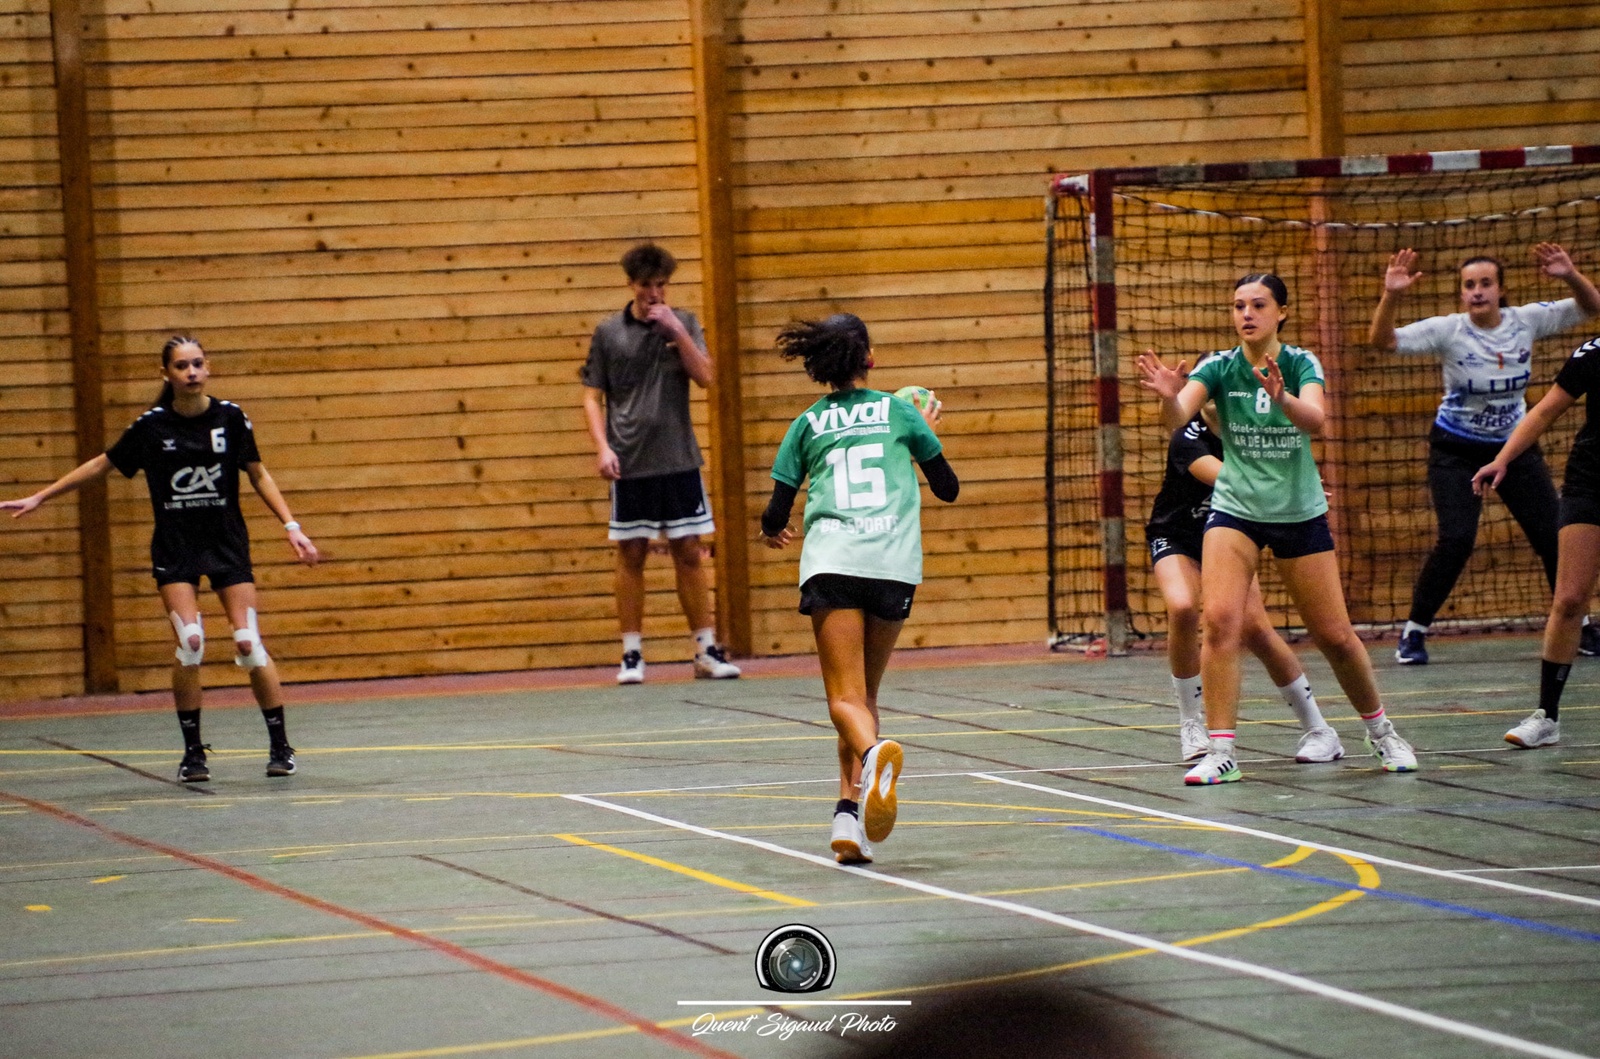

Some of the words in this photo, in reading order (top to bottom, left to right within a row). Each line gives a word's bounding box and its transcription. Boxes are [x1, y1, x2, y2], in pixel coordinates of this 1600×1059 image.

[1255, 387, 1271, 413] 8
[805, 396, 891, 434] vival
[210, 427, 227, 453] 6
[1248, 435, 1260, 448] DE
[1262, 436, 1275, 448] LA
[1276, 435, 1302, 448] LOIRE
[825, 443, 887, 510] 15
